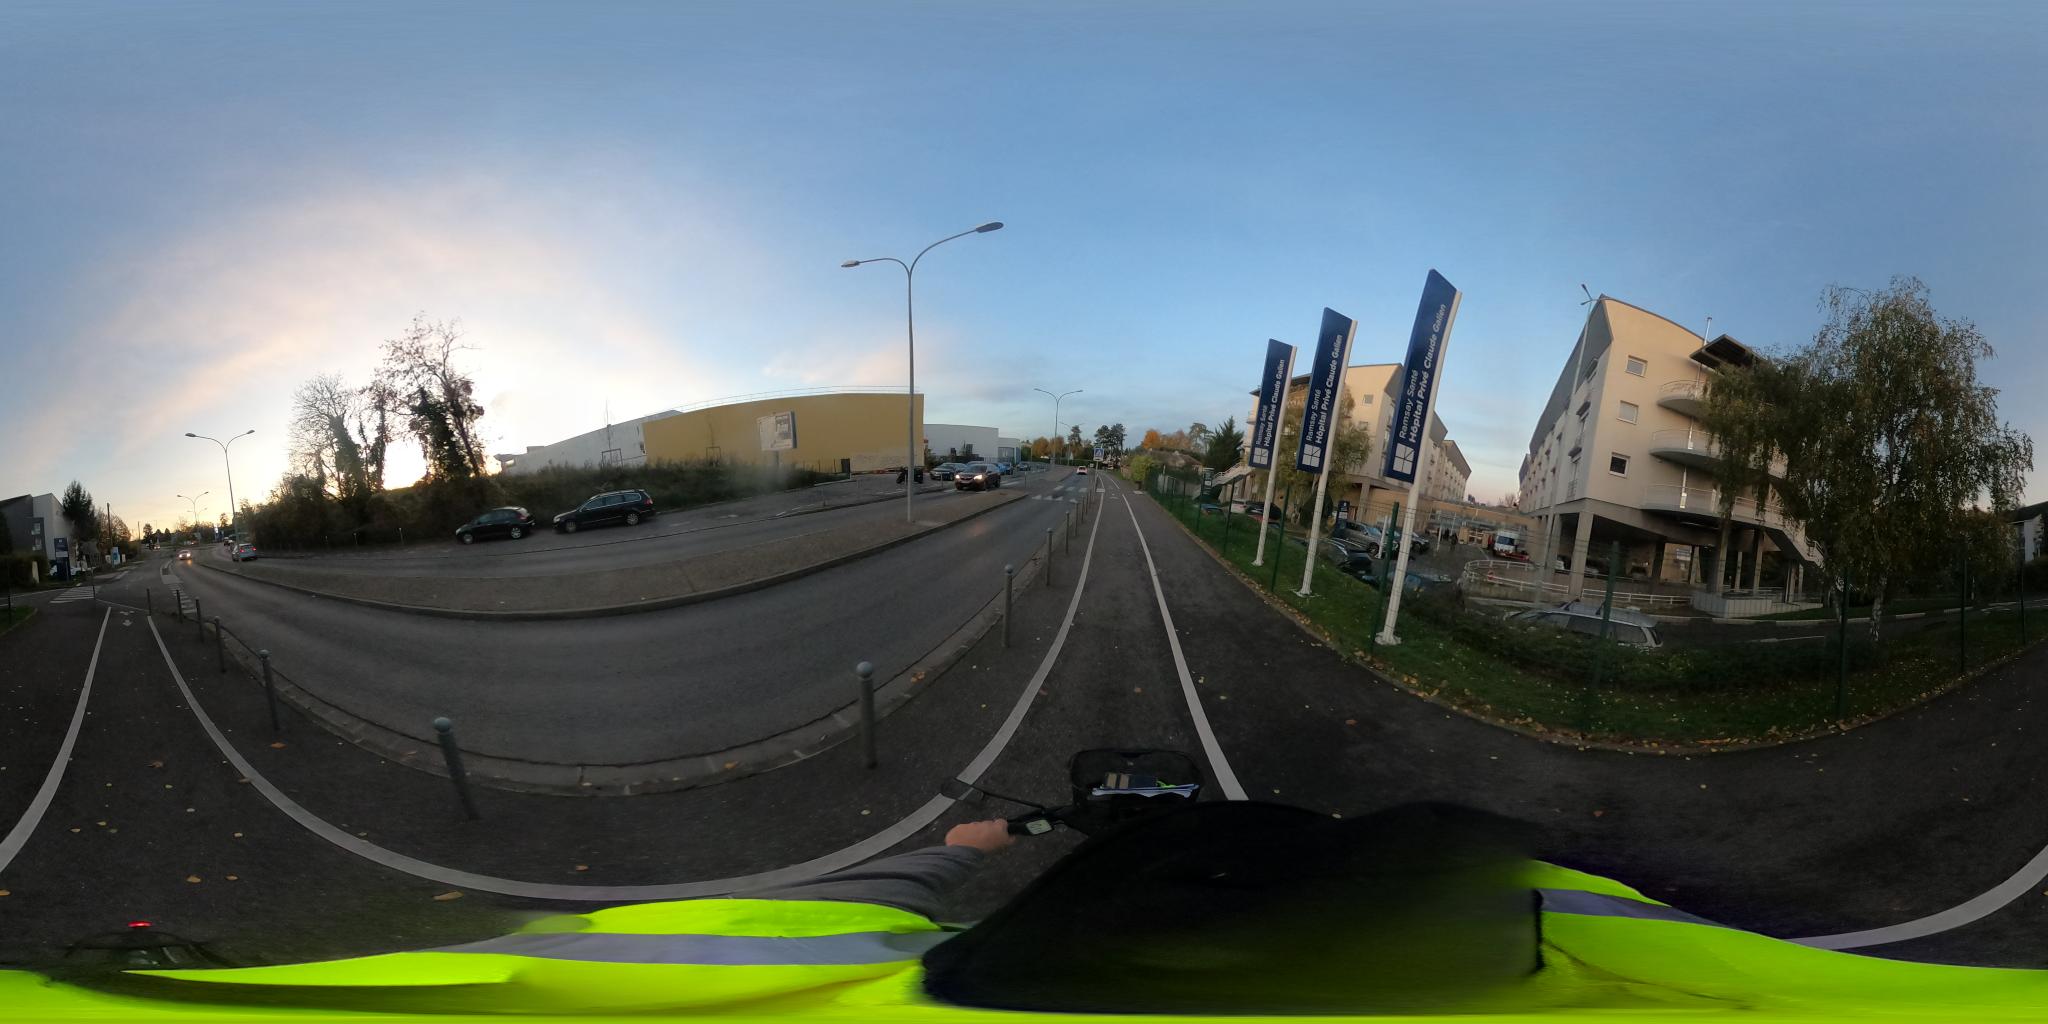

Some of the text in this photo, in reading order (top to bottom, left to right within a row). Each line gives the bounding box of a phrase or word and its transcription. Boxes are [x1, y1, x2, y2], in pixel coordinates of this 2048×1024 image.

[1316, 335, 1342, 444] Hôpital Privé Claude Galien
[1399, 370, 1418, 439] Ramsay Santé
[1409, 304, 1446, 443] Hôpital Privé Claude Galien
[1264, 421, 1272, 446] Hôpital
[1272, 381, 1280, 402] Claude
[1306, 389, 1321, 441] Ramsay Santé
